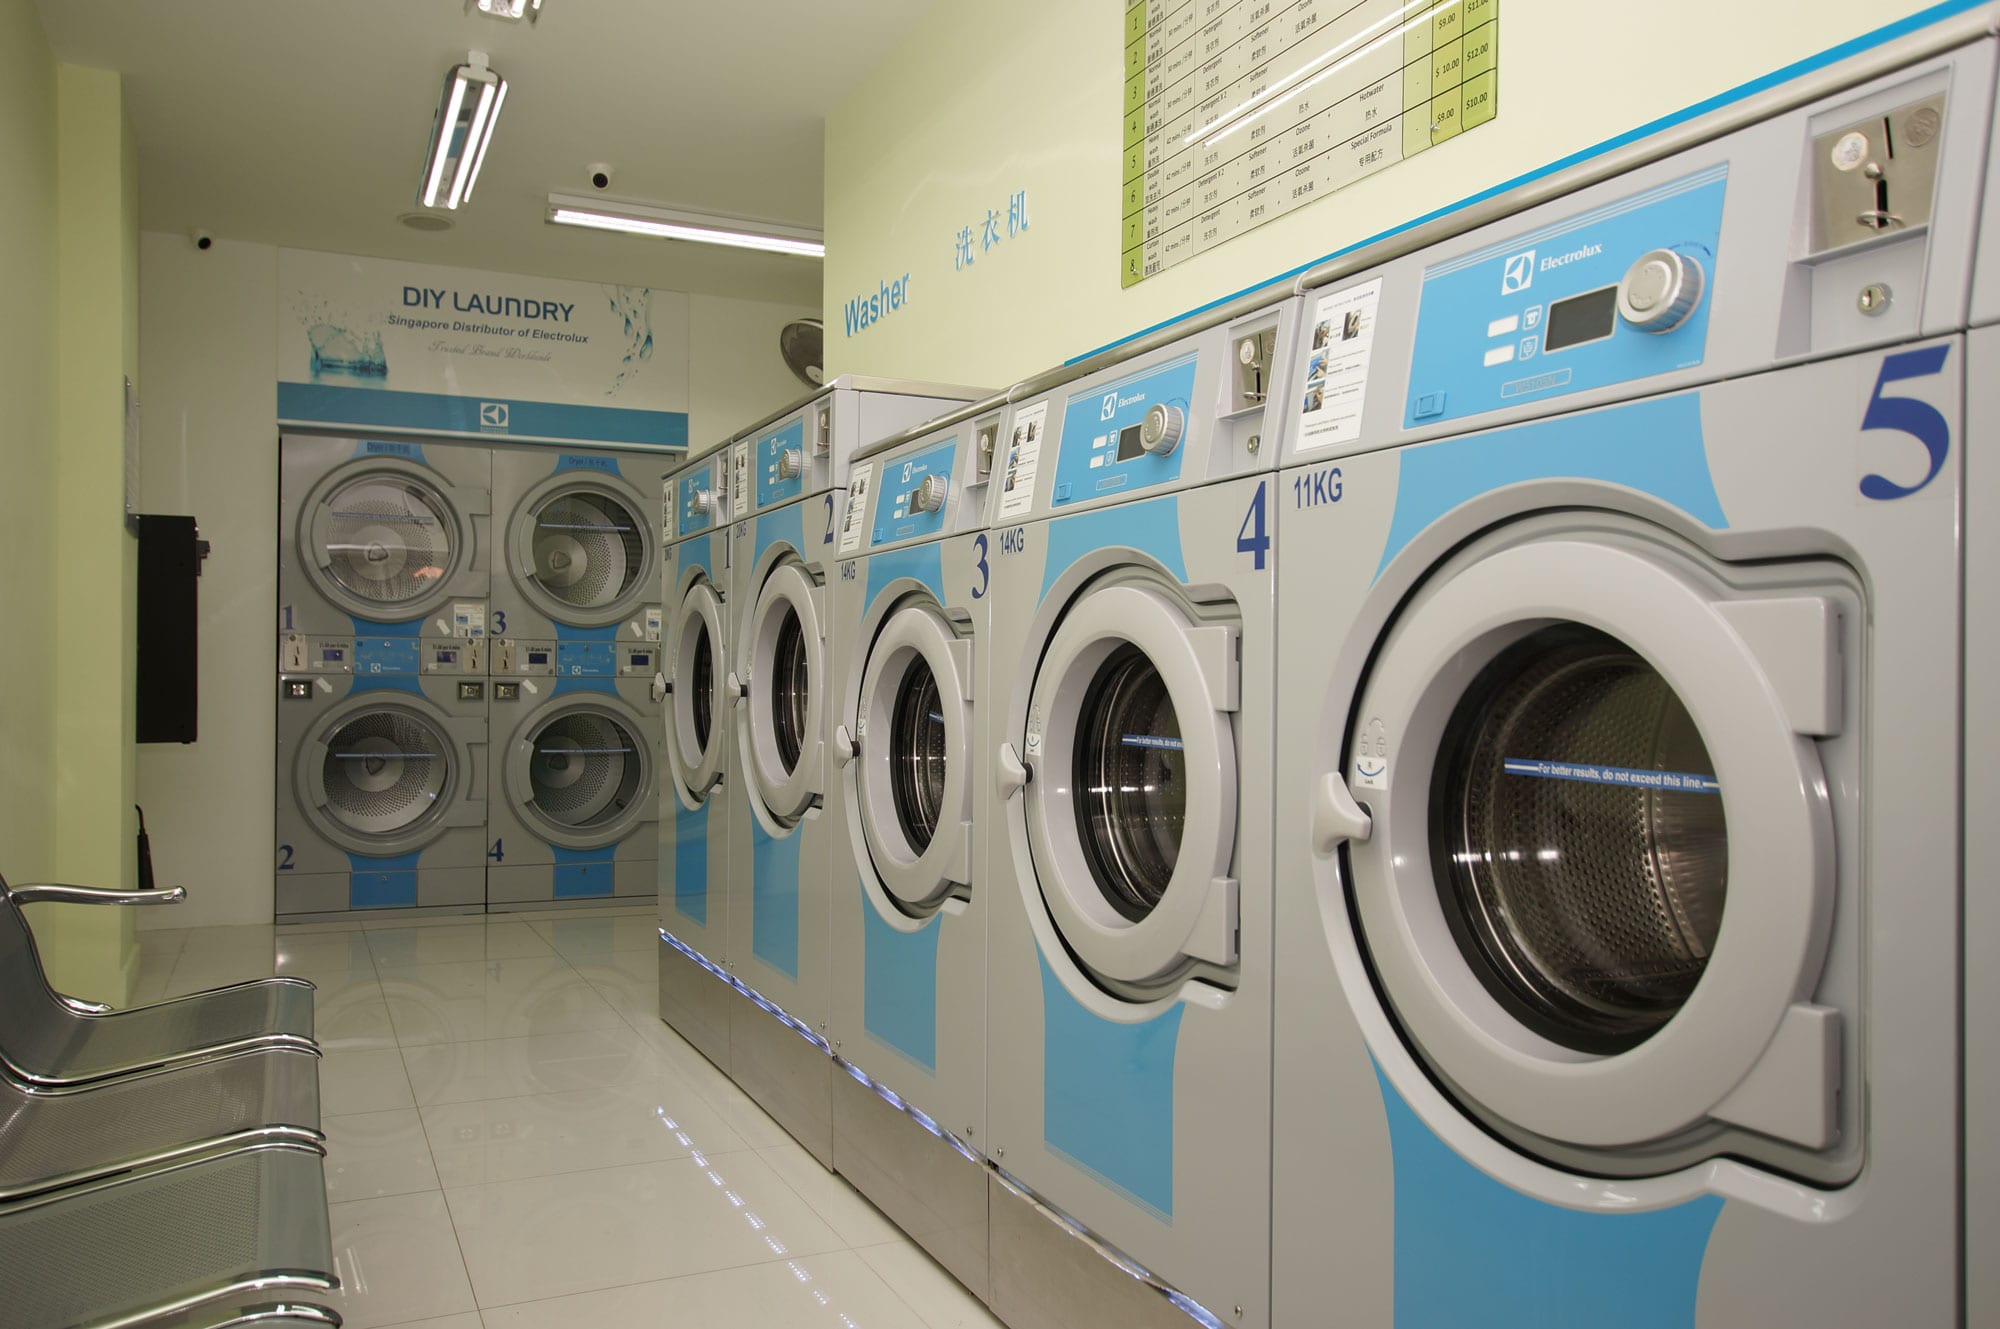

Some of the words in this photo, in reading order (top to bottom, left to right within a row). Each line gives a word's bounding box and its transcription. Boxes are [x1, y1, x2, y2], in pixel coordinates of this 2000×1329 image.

[1467, 0, 1489, 13] $11.0
[1466, 42, 1489, 62] $12.00
[1442, 58, 1460, 74] 10.00
[1360, 84, 1385, 102] Hotwater
[1466, 92, 1488, 110] $10.00
[1437, 108, 1455, 124] $9.00
[1295, 123, 1311, 136] Ozone
[1350, 135, 1369, 150] Special
[1370, 123, 1393, 140] Formula
[1248, 147, 1267, 160] Softener
[1295, 164, 1311, 177] Ozone
[1247, 187, 1266, 200] Softener
[955, 190, 1029, 271] 洗衣机
[1540, 243, 1603, 272] Electrolux
[403, 286, 446, 309] DIY
[453, 291, 575, 323] LAUNDRY
[845, 272, 910, 338] Washer
[388, 314, 449, 330] Singapore
[452, 321, 514, 337] Distributor
[518, 328, 530, 338] of
[532, 329, 589, 344] Electrolux
[1859, 343, 1951, 501] 5
[1294, 467, 1343, 509] 11KG
[824, 494, 834, 545] 2
[1237, 480, 1270, 570] 4
[725, 529, 731, 570] 1
[1000, 527, 1024, 555] 14KG
[841, 561, 856, 580] 14KG
[972, 533, 989, 600] 3
[284, 605, 294, 630] 1
[491, 611, 507, 635] 3
[1538, 763, 1549, 774] For
[1551, 764, 1571, 777] better
[1573, 767, 1600, 780] results,
[1602, 769, 1614, 781] do
[1615, 771, 1629, 783] not
[1631, 773, 1661, 786] exceed
[1663, 775, 1680, 787] this
[1683, 776, 1703, 788] line.
[278, 845, 295, 870] 2
[488, 838, 504, 862] 4
